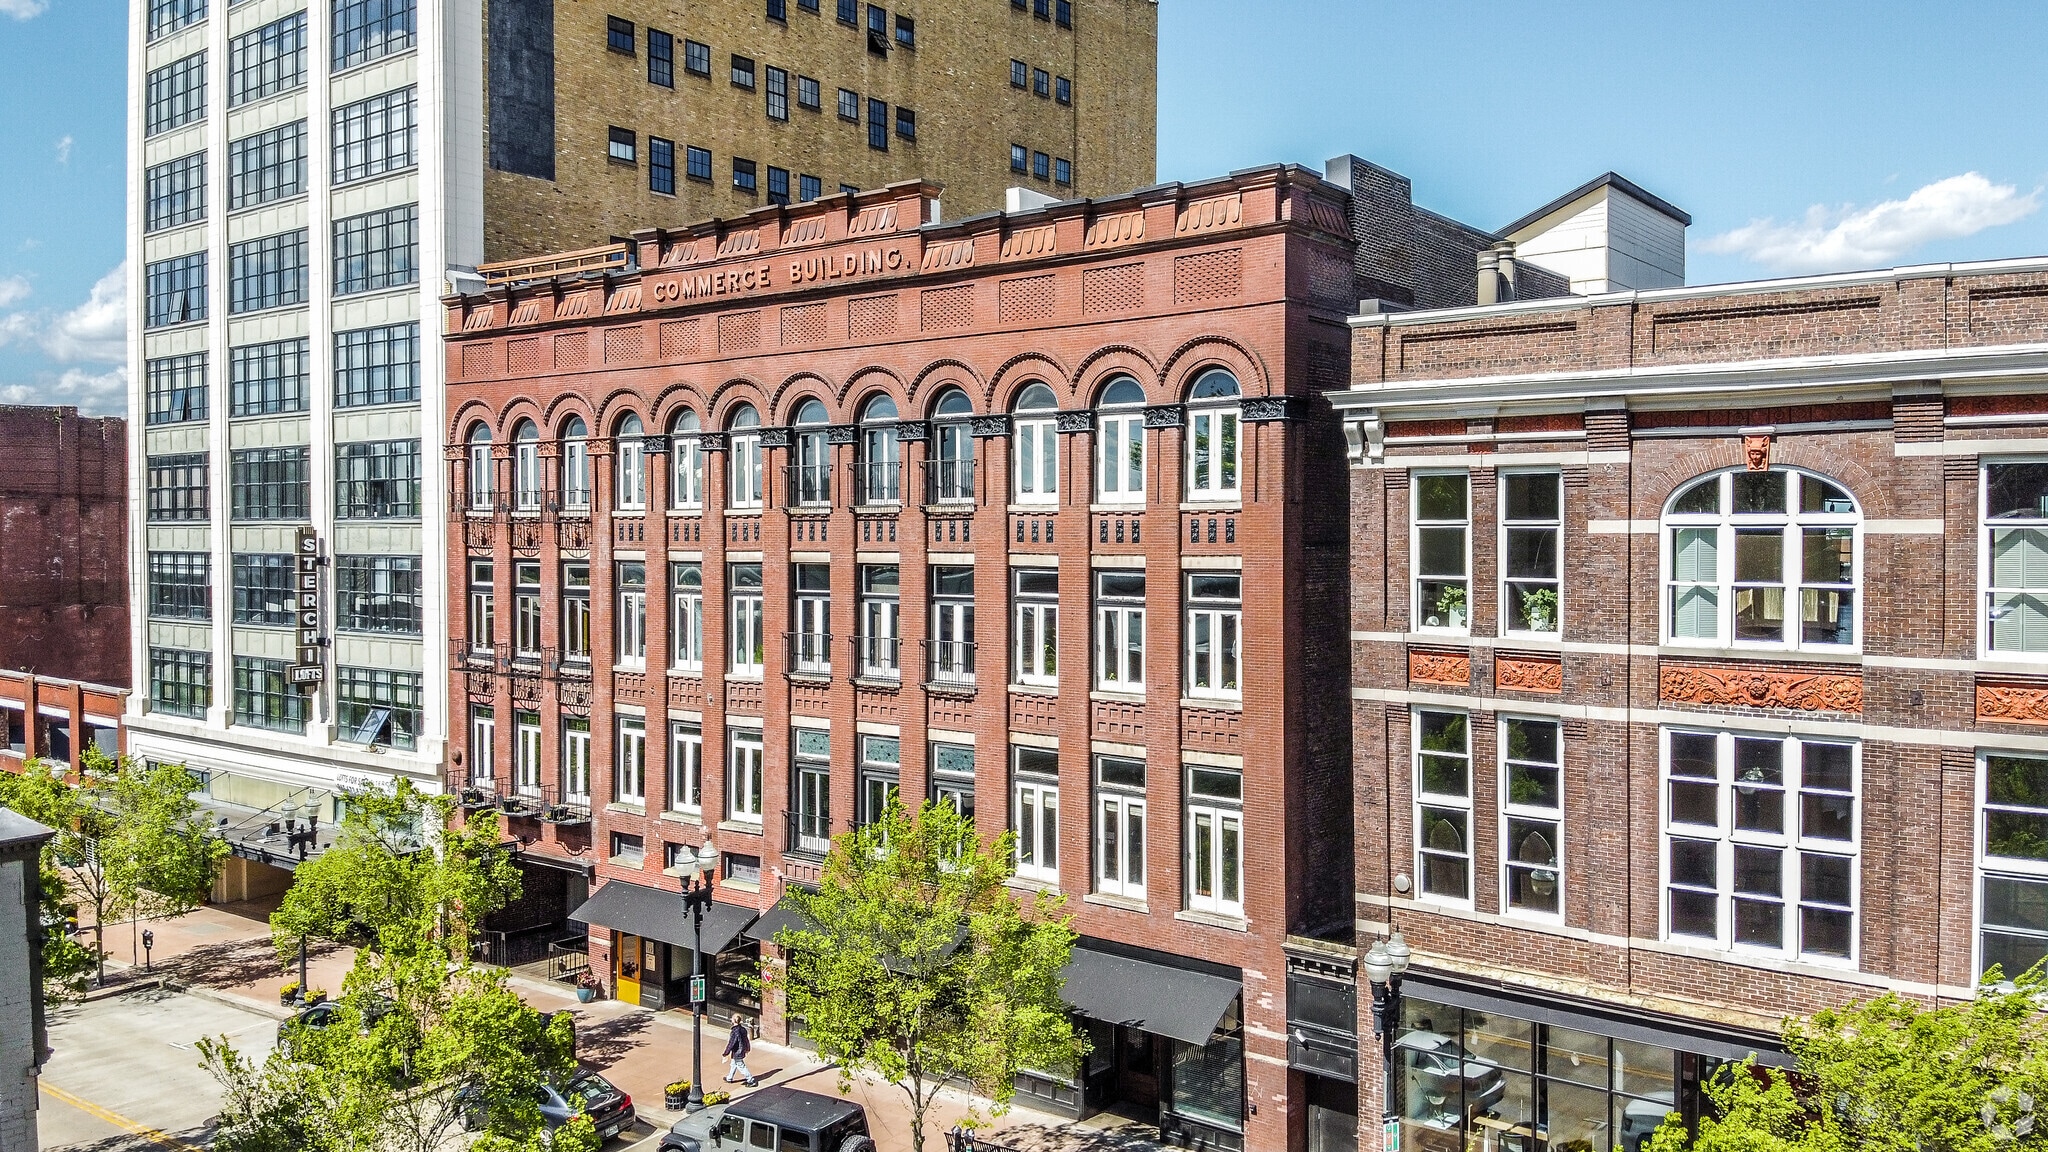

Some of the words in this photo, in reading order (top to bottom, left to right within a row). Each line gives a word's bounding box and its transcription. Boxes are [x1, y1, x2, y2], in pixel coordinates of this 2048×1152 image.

[654, 265, 771, 302] COMMERCE
[302, 538, 317, 662] STERCHI
[294, 668, 322, 681] LOFTS
